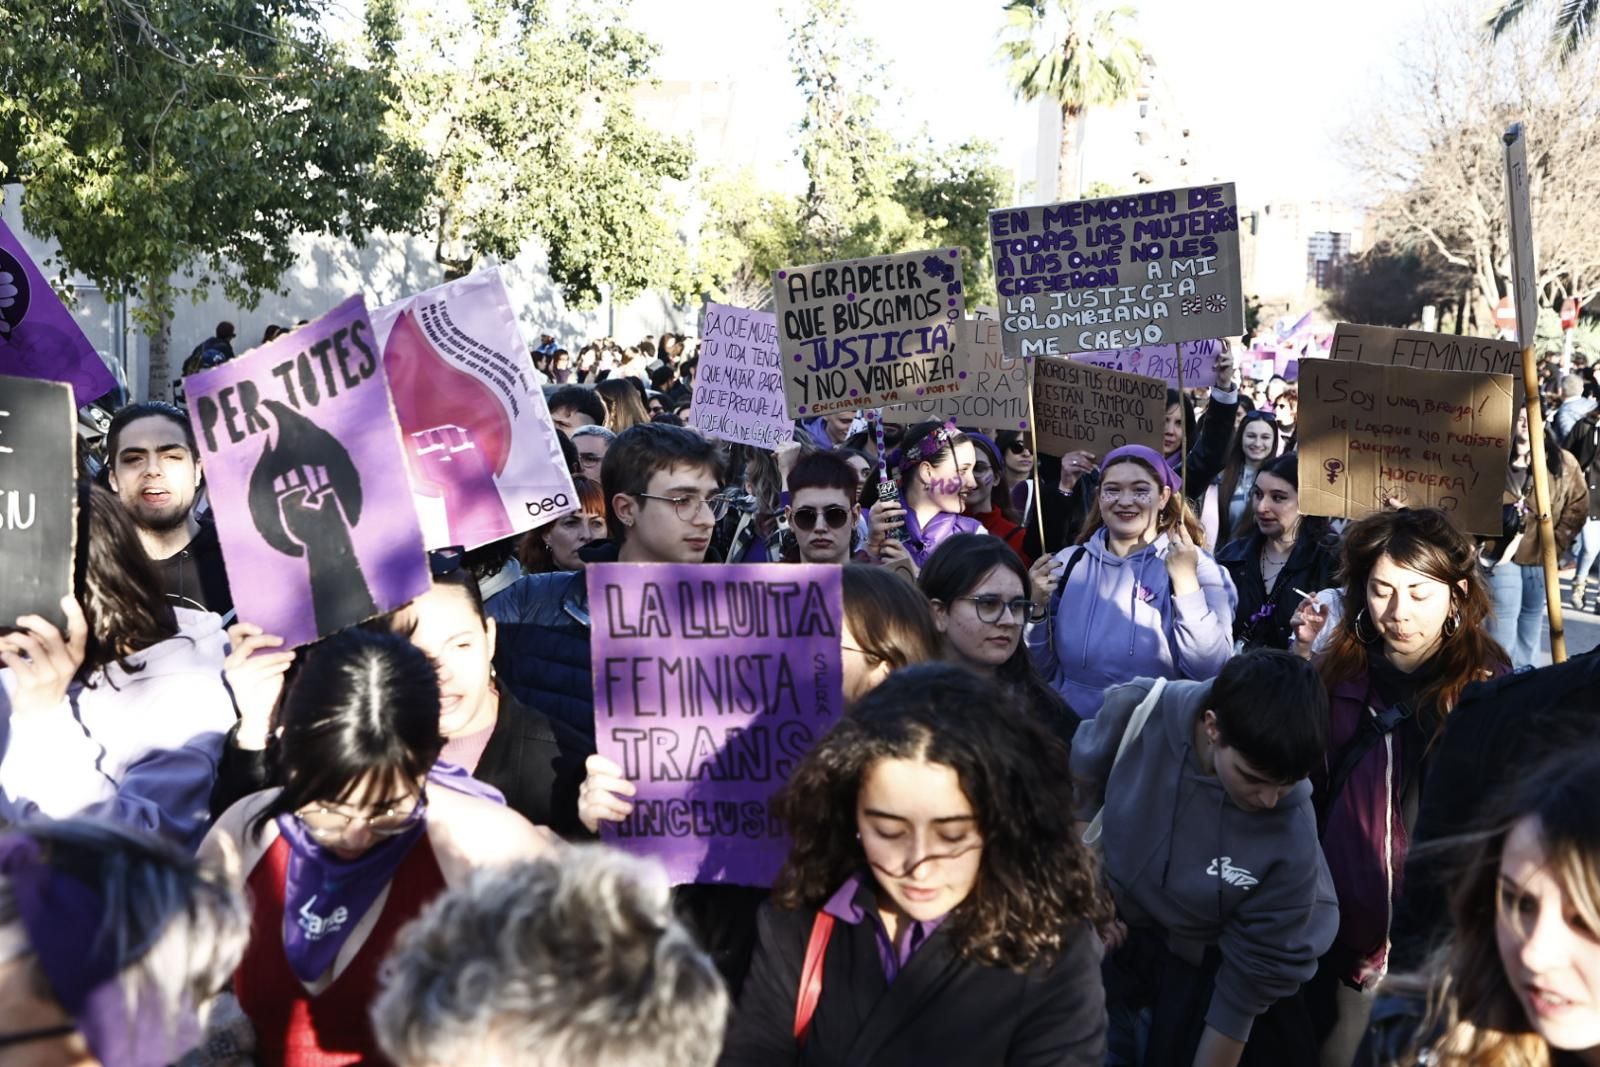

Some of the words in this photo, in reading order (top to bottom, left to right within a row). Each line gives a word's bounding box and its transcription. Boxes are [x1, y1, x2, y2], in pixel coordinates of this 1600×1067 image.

[992, 210, 1029, 236] EN
[1043, 190, 1176, 231] MEMORIA
[1188, 187, 1224, 209] DE
[994, 229, 1078, 257] TODAS
[1086, 223, 1126, 247] LAS
[1133, 205, 1238, 242] MUJERES
[997, 256, 1015, 277] A
[1020, 253, 1062, 274] LAS
[1068, 246, 1121, 269] QUE
[1131, 243, 1165, 262] NO
[1169, 236, 1218, 258] LES
[788, 261, 922, 304] AGRADECER
[997, 268, 1119, 297] CREYERON
[1147, 261, 1163, 280] A
[1171, 255, 1217, 279] MI
[784, 306, 827, 341] QUE
[832, 288, 942, 335] BUSCAMOS
[1003, 301, 1169, 333] COLOMBIANA
[1181, 293, 1228, 316] NO
[1006, 296, 1036, 315] LA
[1050, 277, 1196, 311] JUSTICIA
[704, 339, 719, 357] TU
[725, 343, 747, 365] VIDA
[747, 321, 778, 345] MUJE
[1021, 335, 1060, 357] ME
[1078, 319, 1163, 350] CREYÓ
[1189, 340, 1215, 355] SIN
[197, 380, 271, 453] PER
[272, 319, 376, 410] TOTES
[701, 364, 721, 384] QUE
[721, 365, 755, 390] MATAR
[756, 371, 784, 393] PARA
[793, 374, 809, 405] Y
[816, 370, 847, 401] NO
[854, 353, 954, 394] VENGANZA
[881, 391, 899, 402] VA
[1069, 368, 1079, 385] SI
[1082, 370, 1103, 390] TUS
[1107, 375, 1165, 400] CUIDADOS
[696, 386, 715, 405] QUE
[716, 389, 729, 407] TE
[771, 400, 784, 423] LA
[1084, 408, 1125, 430] ESTAR
[1136, 417, 1154, 433] TU
[1091, 391, 1144, 416] TAMPOCO
[740, 425, 750, 441] DE
[1037, 418, 1095, 442] APELLIDO
[525, 493, 569, 516] bea
[605, 581, 671, 639] LA
[677, 580, 836, 639] LLUITA
[604, 652, 801, 718] FEMINISTA
[612, 721, 814, 783] TRANS
